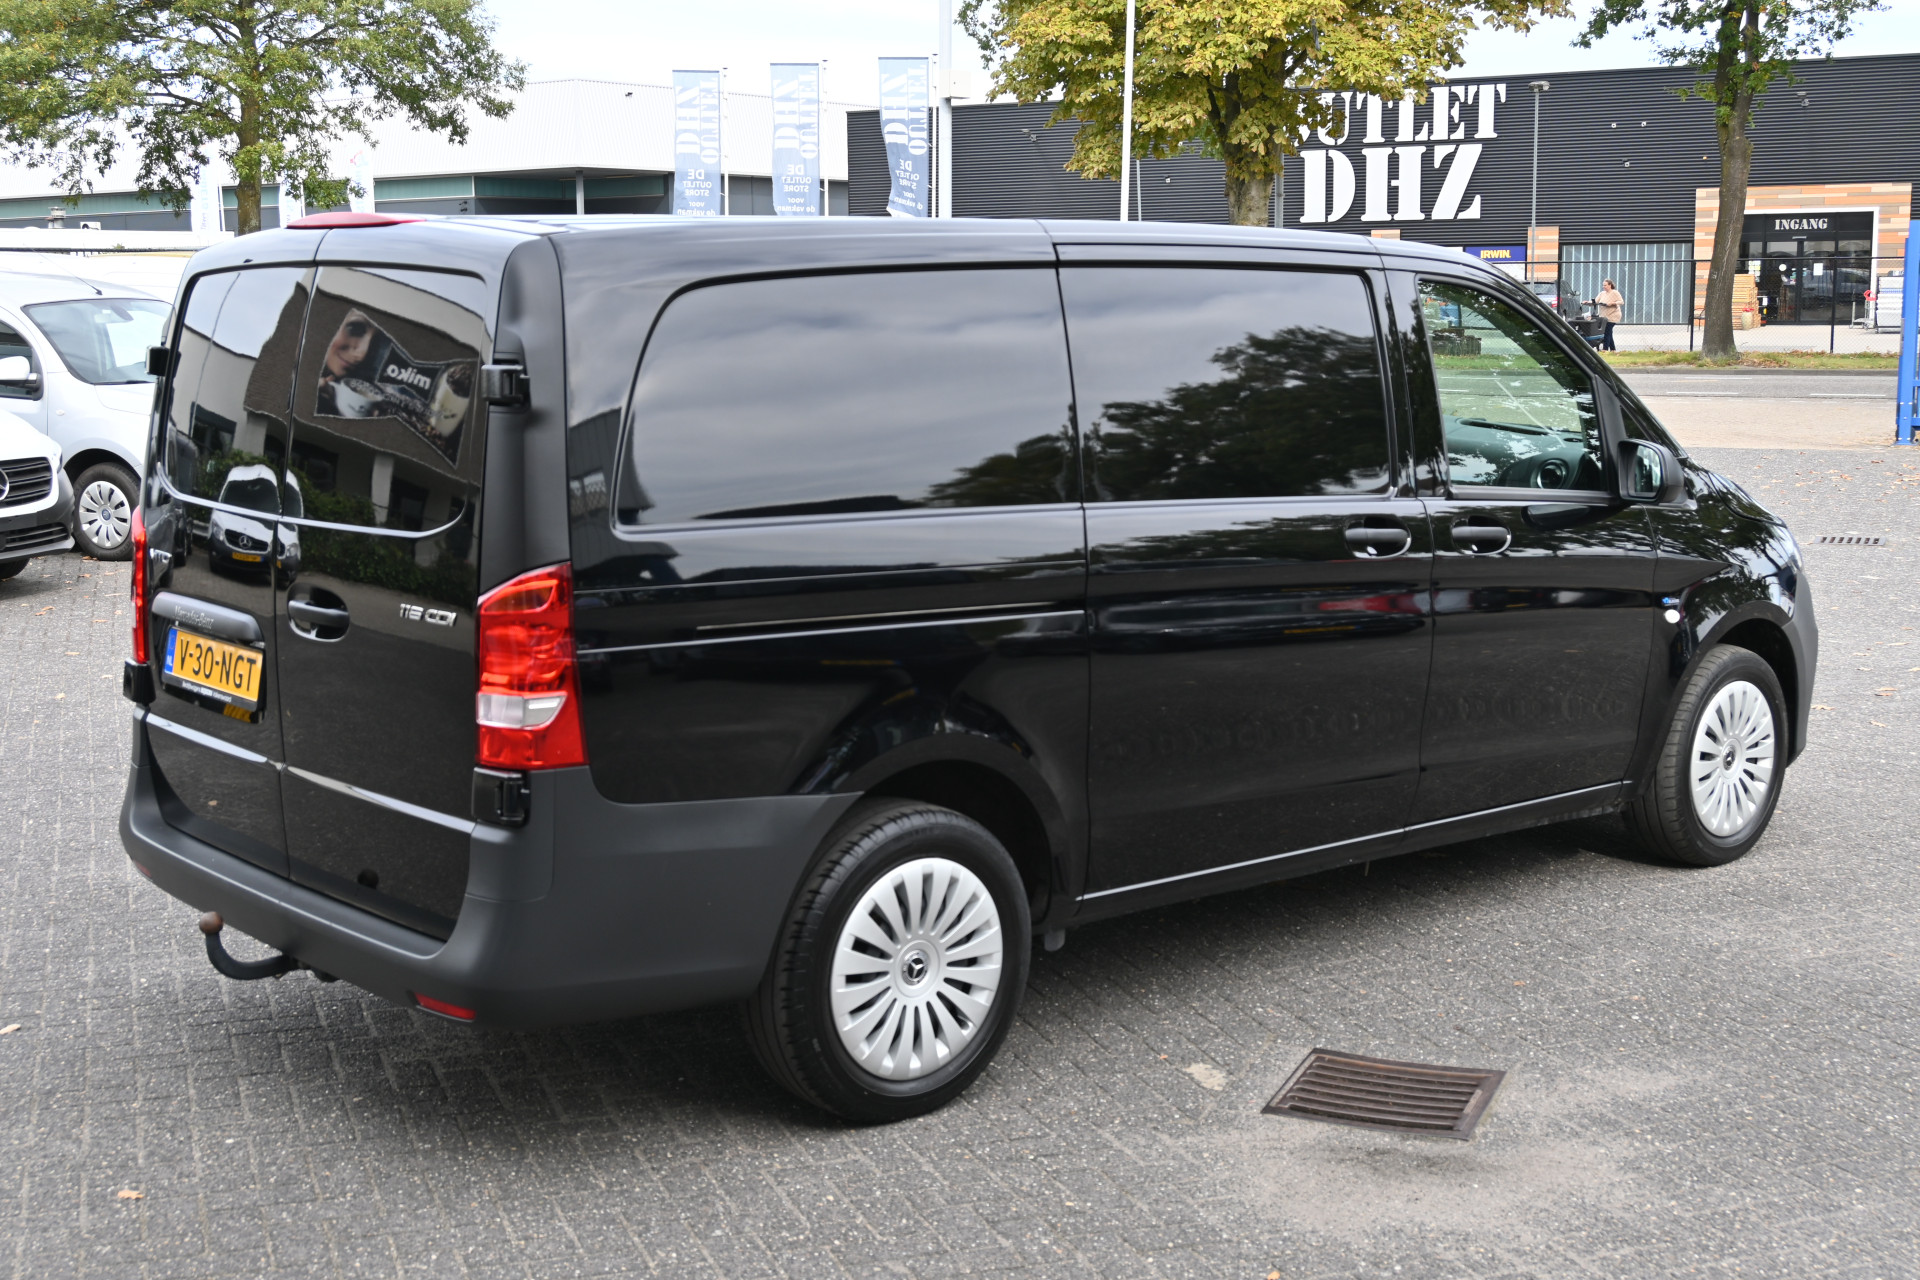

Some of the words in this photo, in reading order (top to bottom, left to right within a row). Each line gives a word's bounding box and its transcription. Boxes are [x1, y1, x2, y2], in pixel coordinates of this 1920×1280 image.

[1293, 83, 1507, 146] UTLET
[1300, 143, 1483, 223] DHZ
[1774, 218, 1828, 231] INGANG
[1480, 249, 1511, 259] IRWIN
[424, 608, 457, 627] CDI
[180, 638, 257, 692] V-30-NGT
